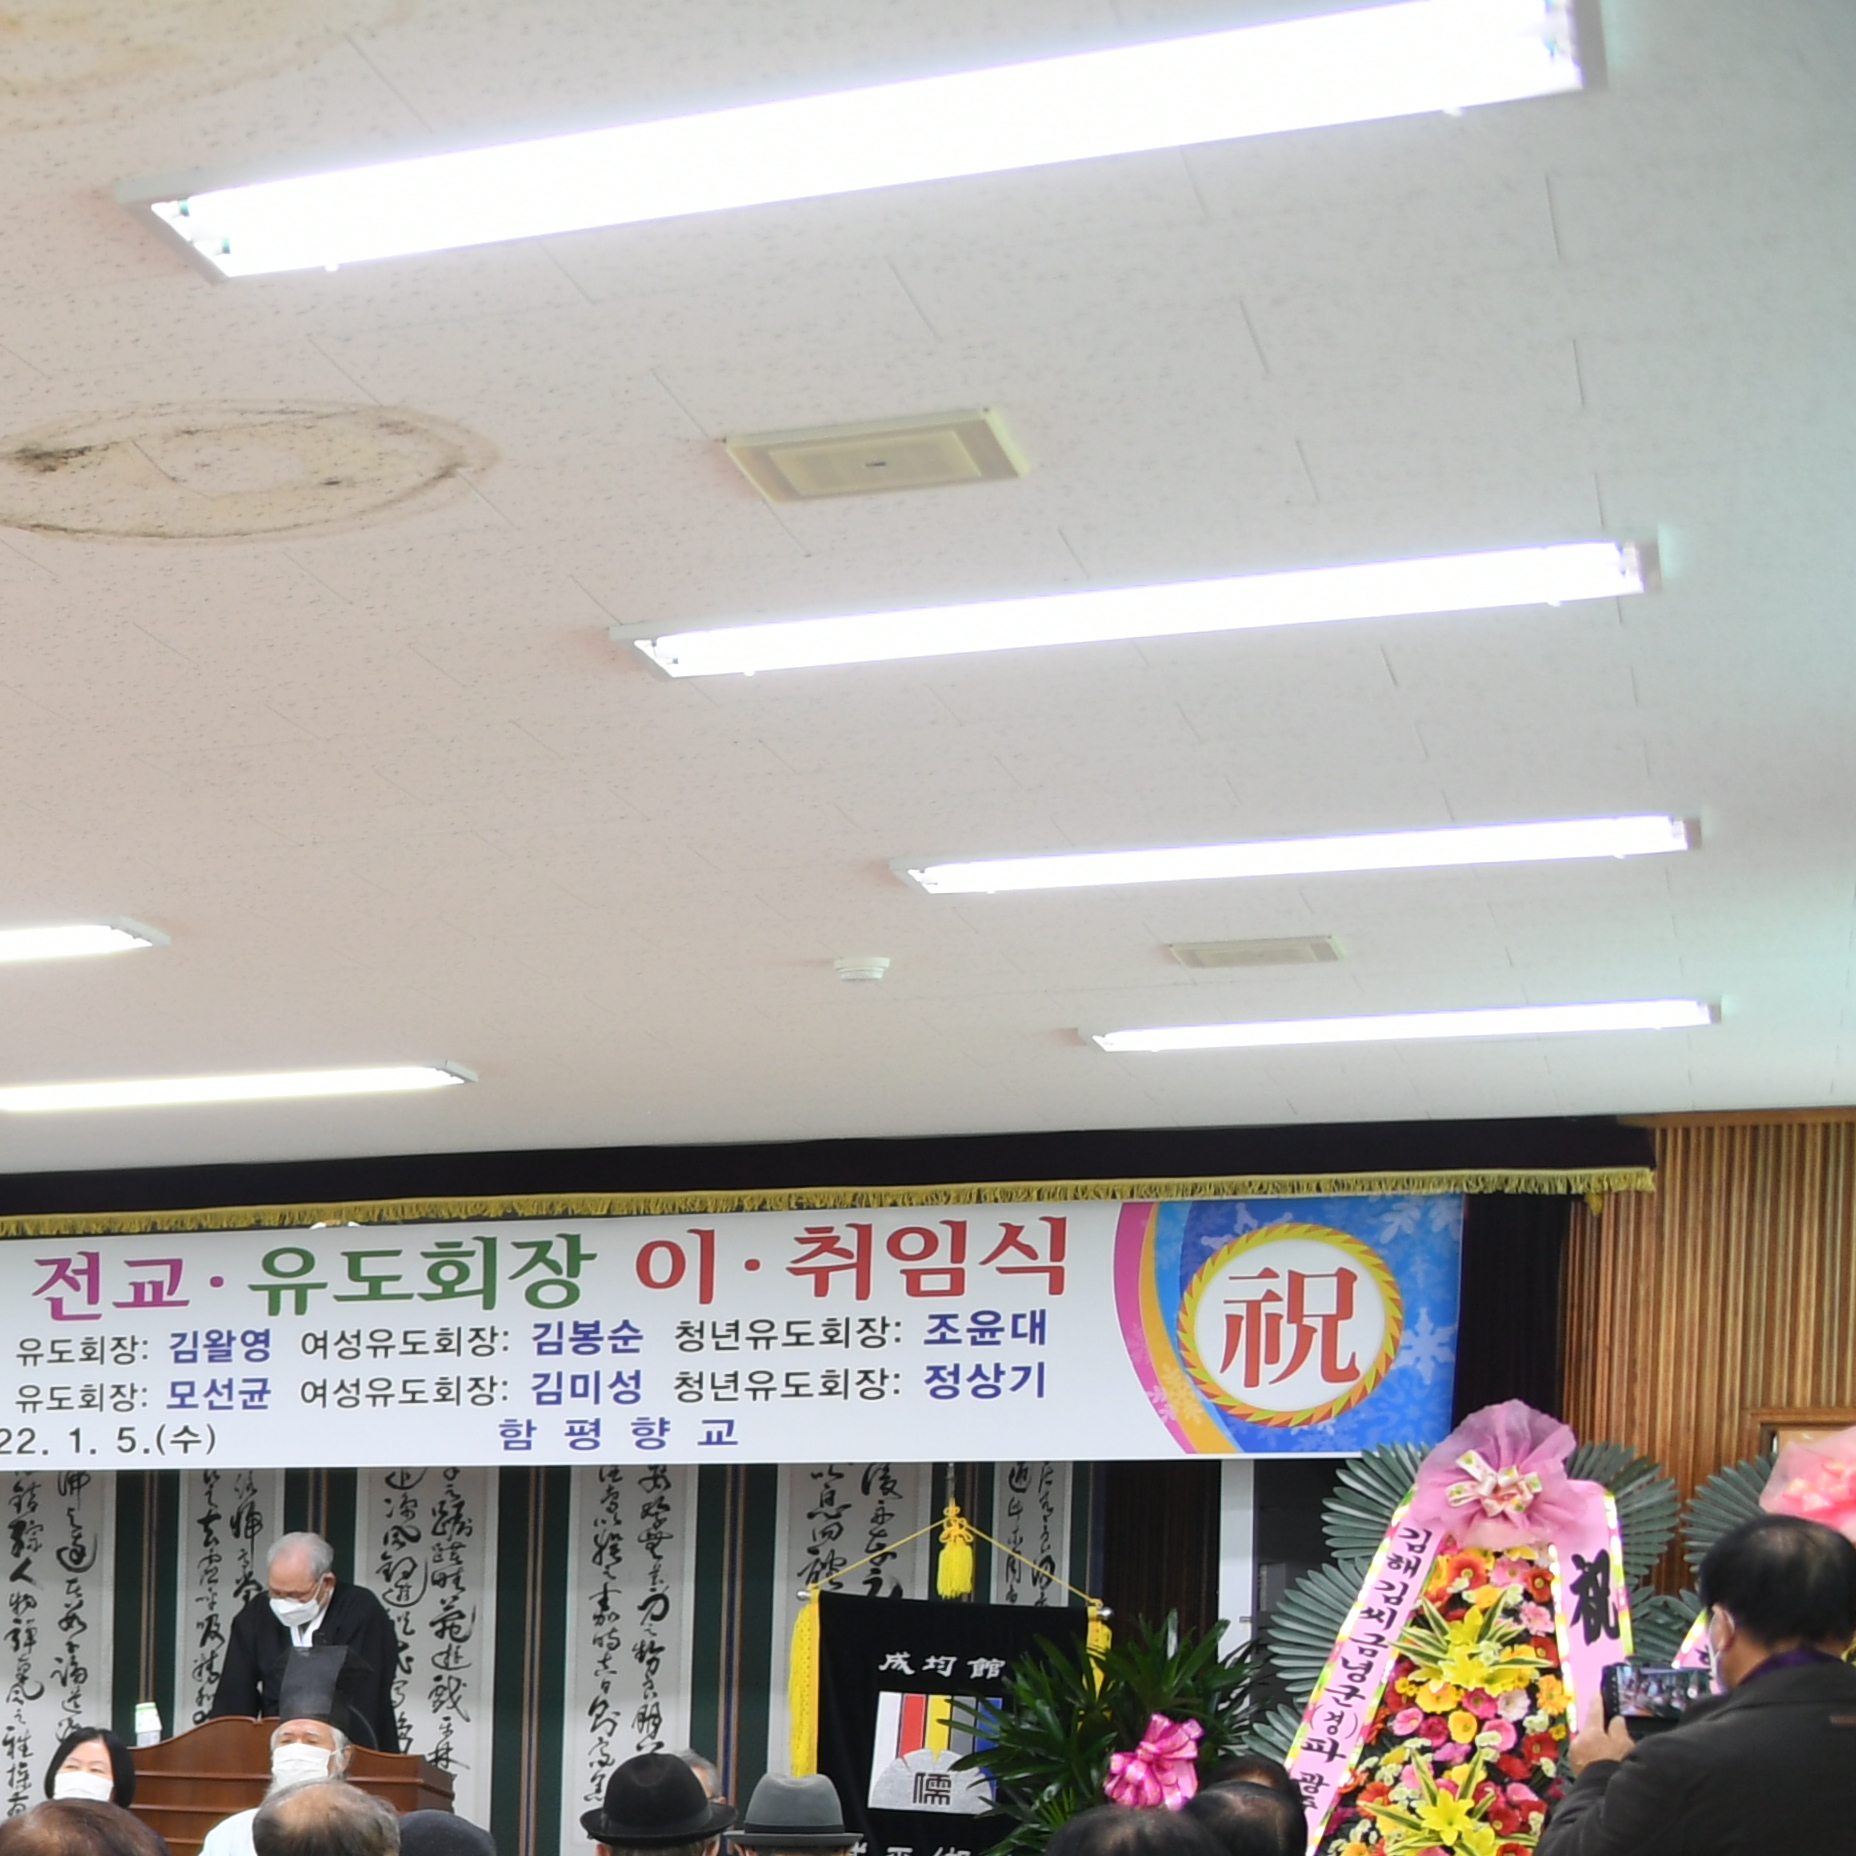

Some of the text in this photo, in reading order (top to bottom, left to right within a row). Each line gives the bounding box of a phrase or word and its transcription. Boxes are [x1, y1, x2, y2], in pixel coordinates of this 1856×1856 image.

[16, 1335, 149, 1367] 유도회장:
[169, 1329, 271, 1364] 김왈영
[301, 1326, 510, 1361] 여성유도회장:
[532, 1320, 644, 1356] 김봉순
[674, 1317, 902, 1353] 청년유도회장:
[924, 1309, 1047, 1347] 조윤대
[1219, 1266, 1361, 1389] 祝
[15, 1383, 148, 1414] 유도회장:
[166, 1378, 272, 1411] 모선균
[300, 1375, 509, 1409] 여성유도회장:
[531, 1370, 643, 1406] 김미성
[673, 1368, 901, 1404] 청년유도회장:
[924, 1362, 1046, 1400] 정상기
[69, 1427, 97, 1455] 1.
[1570, 1549, 1621, 1643] 祝
